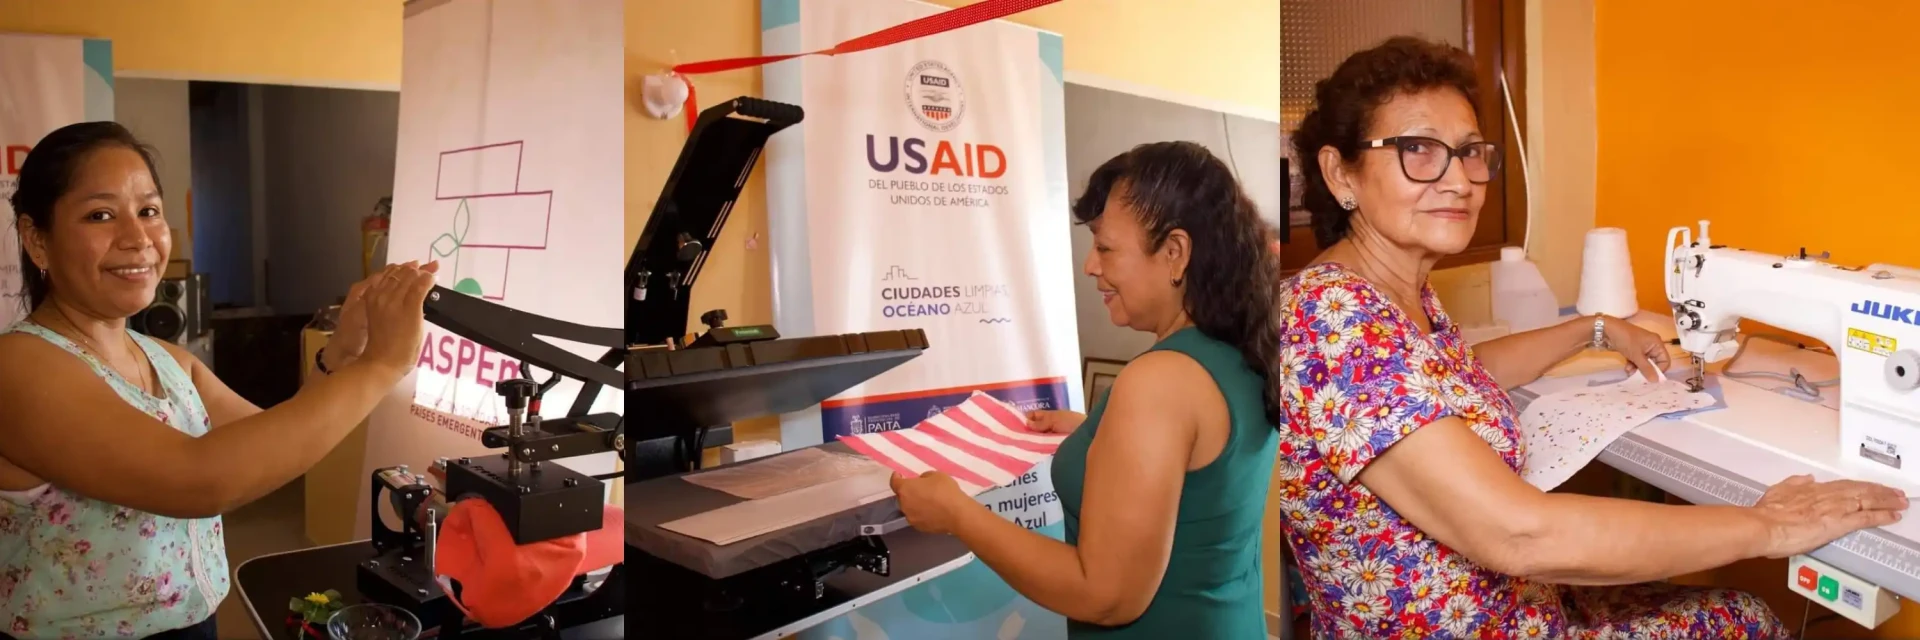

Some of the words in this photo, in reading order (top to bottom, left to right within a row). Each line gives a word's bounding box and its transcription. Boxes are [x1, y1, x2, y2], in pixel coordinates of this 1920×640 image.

[923, 77, 947, 86] USAID
[866, 134, 1007, 178] USAID
[869, 179, 887, 190] DEL
[890, 180, 929, 191] PUEBLO
[932, 182, 945, 192] DE
[948, 183, 966, 193] LOS
[968, 184, 1009, 195] ESTADOS
[890, 195, 931, 205] UNIDOS
[934, 197, 947, 206] DE
[950, 196, 989, 207] AMÉRICA
[881, 286, 960, 300] CIUDADES
[882, 301, 951, 317] OCÉANO
[954, 302, 989, 314] AZUL
[437, 415, 482, 441] EMERGENT
[868, 421, 901, 433] PAITA
[998, 491, 1057, 512] mujeres
